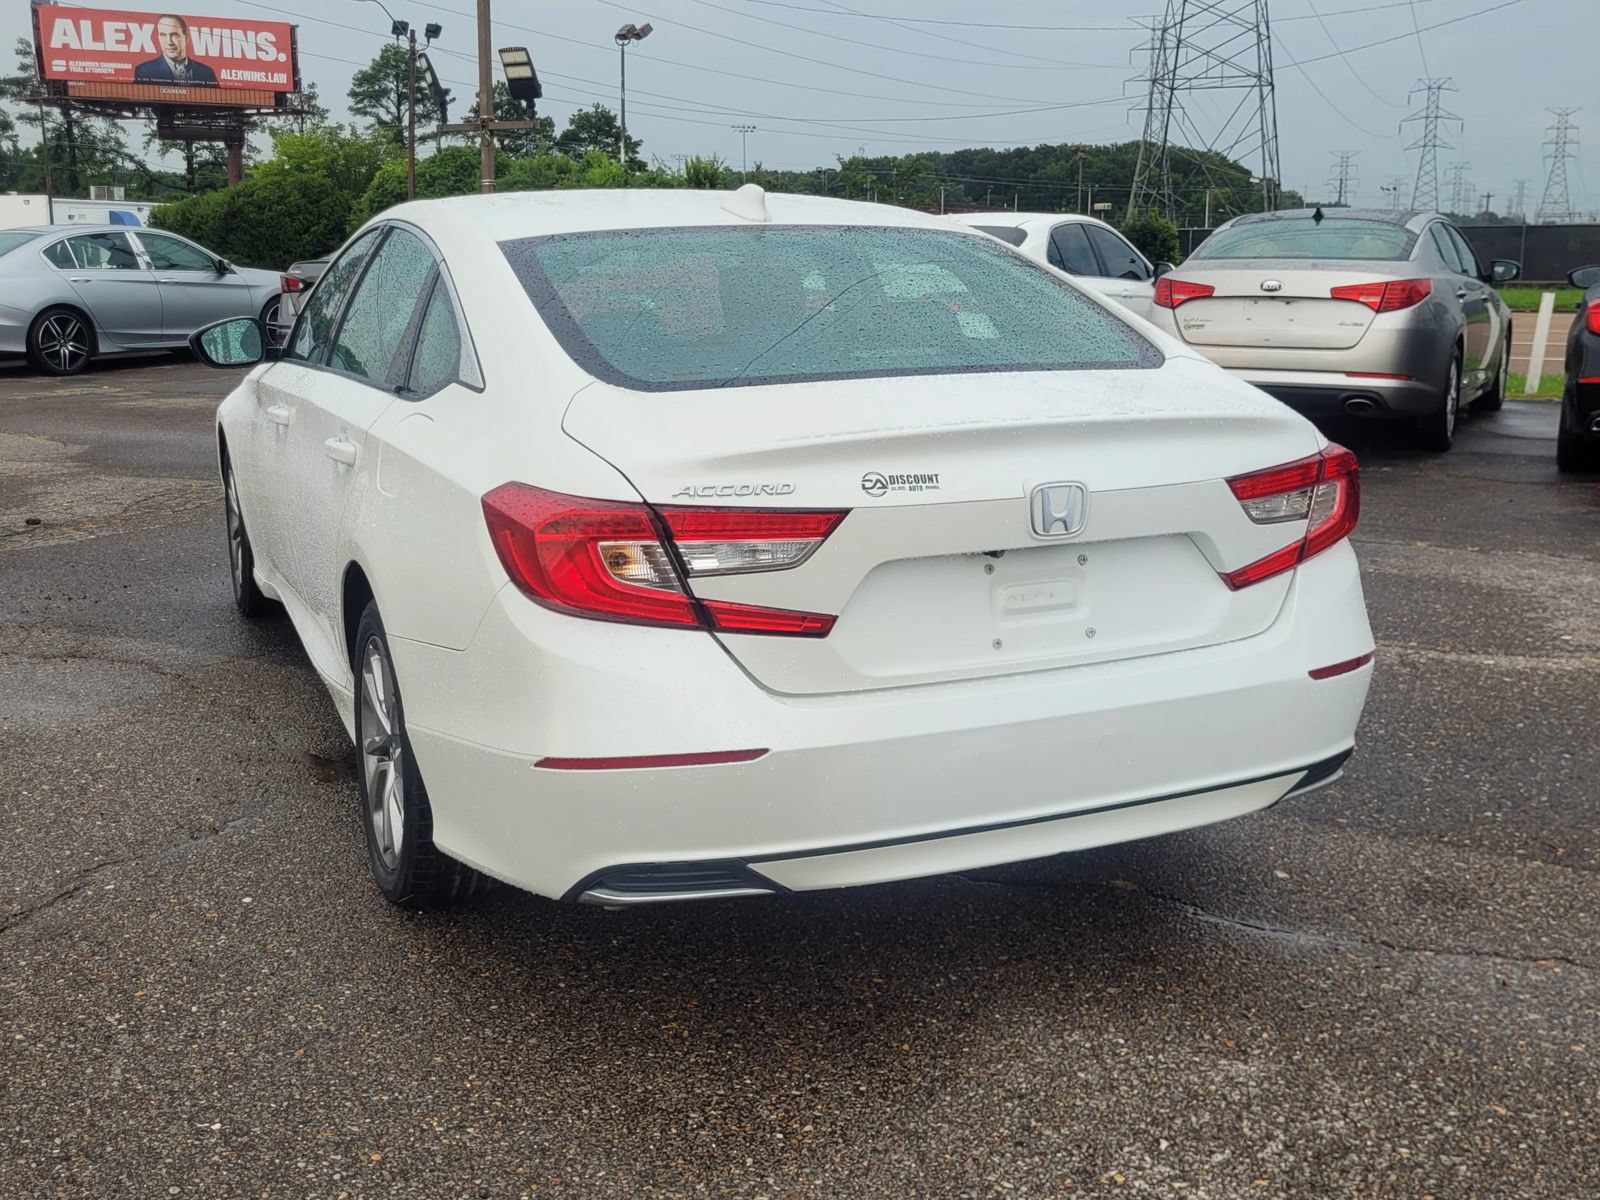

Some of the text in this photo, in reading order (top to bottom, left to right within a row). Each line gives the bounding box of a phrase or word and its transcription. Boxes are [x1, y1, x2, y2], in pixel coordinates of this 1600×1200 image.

[50, 18, 287, 62] ALEX WINS.
[221, 68, 287, 84] ALEXWINS.LAW
[888, 473, 939, 485] DISCOUNT
[672, 483, 796, 498] ACCORD
